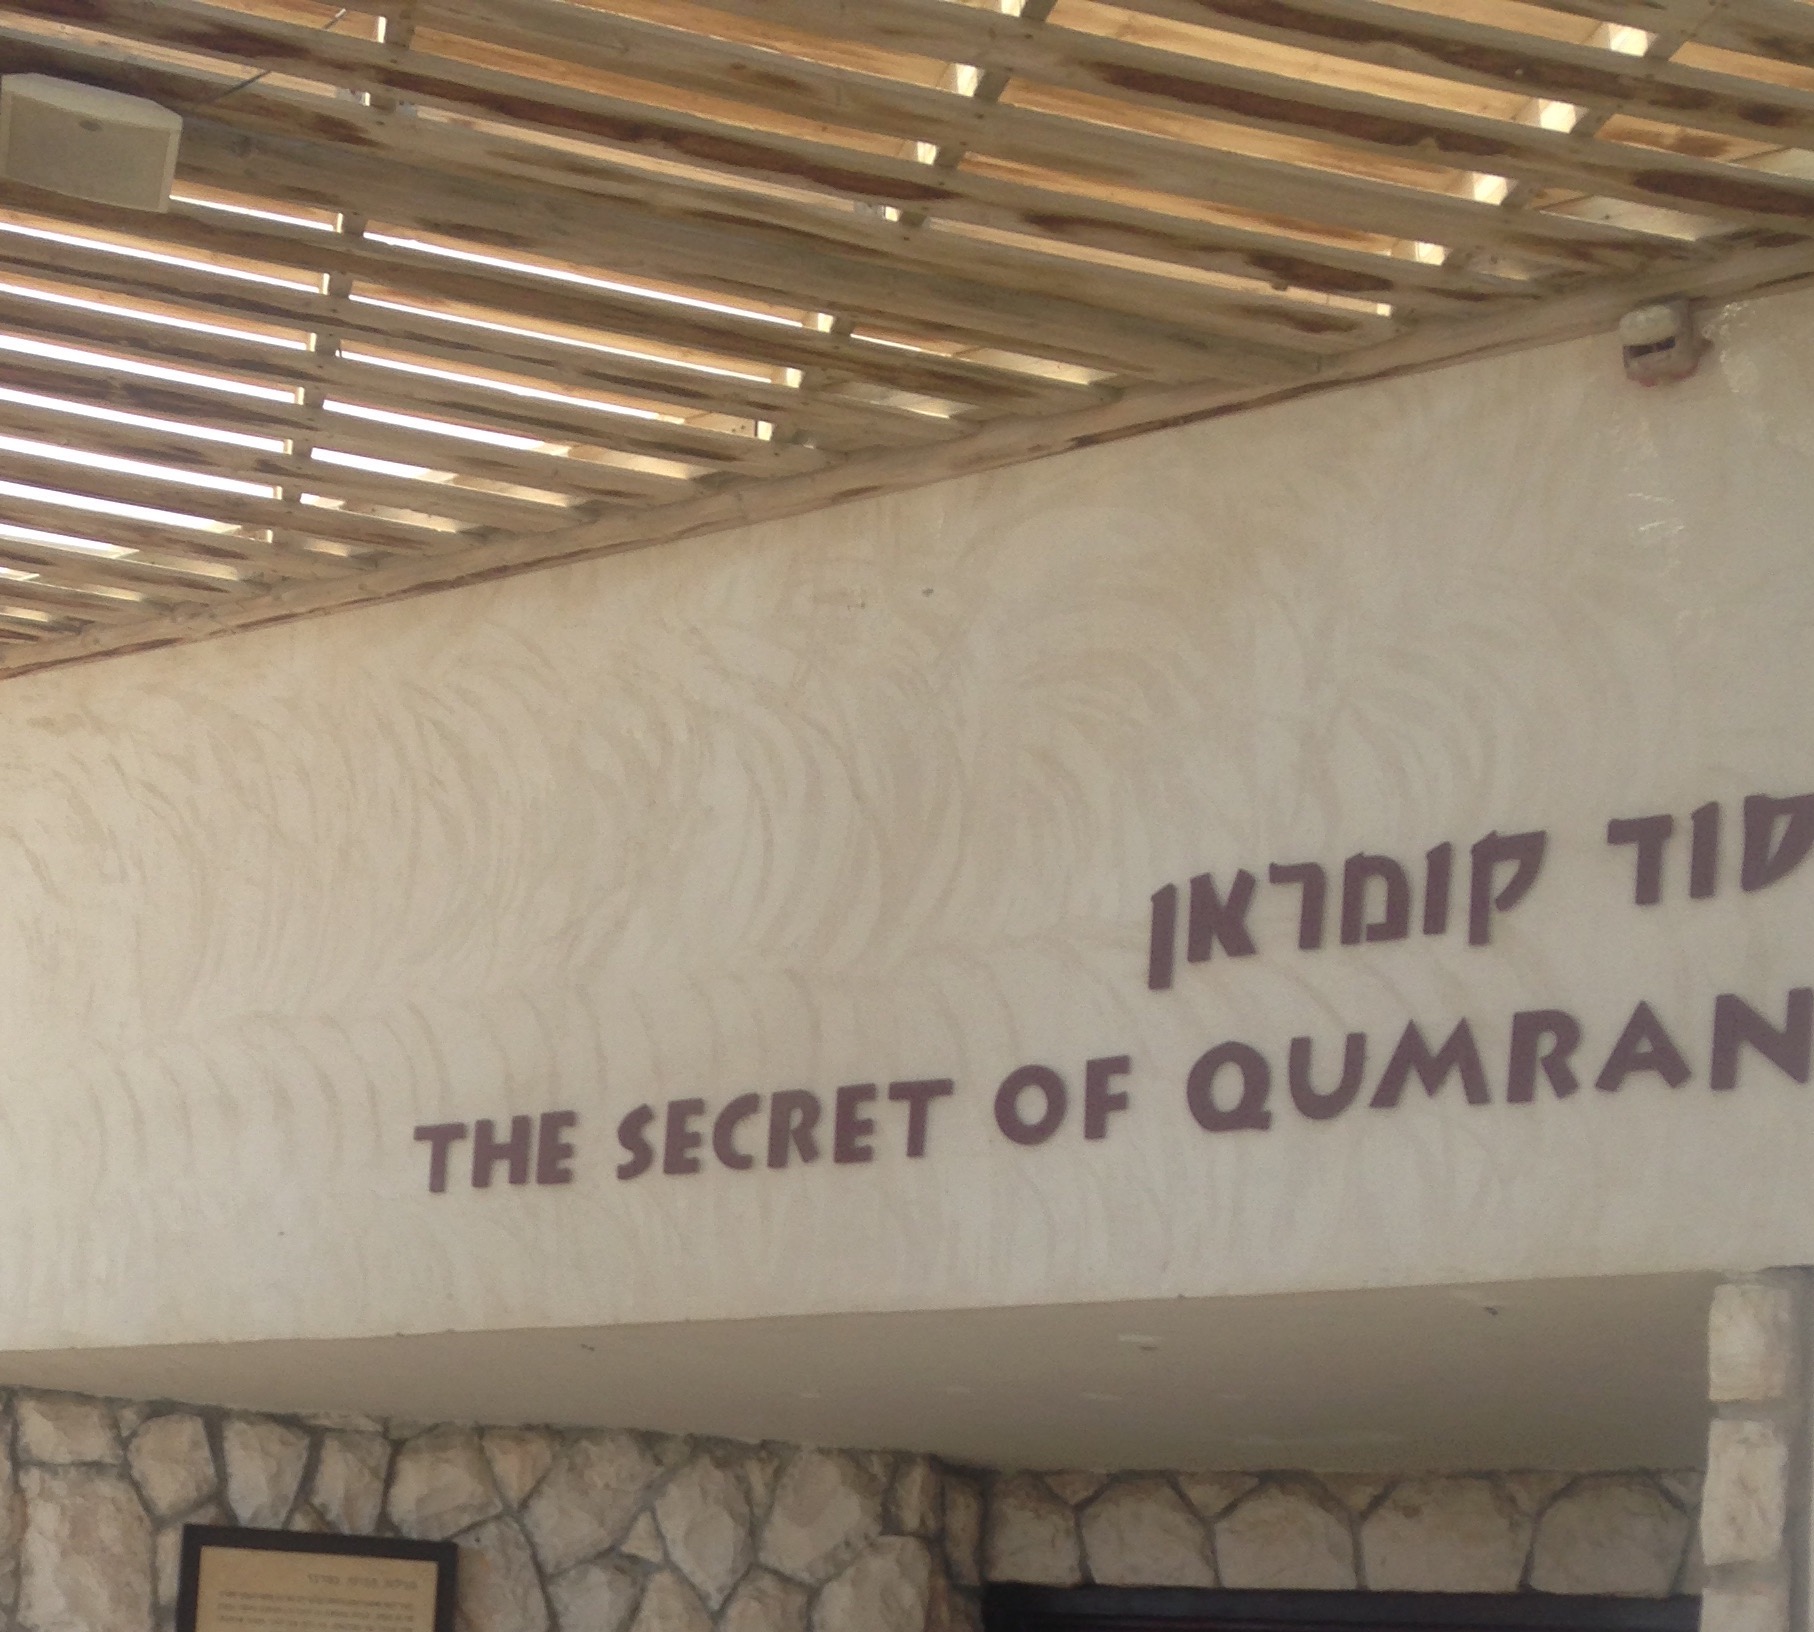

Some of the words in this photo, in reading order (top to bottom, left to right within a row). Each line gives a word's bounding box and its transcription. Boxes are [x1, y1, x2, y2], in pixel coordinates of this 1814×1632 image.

[1148, 829, 1548, 991] קומראן
[1607, 793, 1814, 906] סוד
[413, 1110, 578, 1193] THE
[616, 1078, 955, 1180] SECRET
[994, 1055, 1131, 1146] OF
[1186, 987, 1814, 1132] QUMRAN
